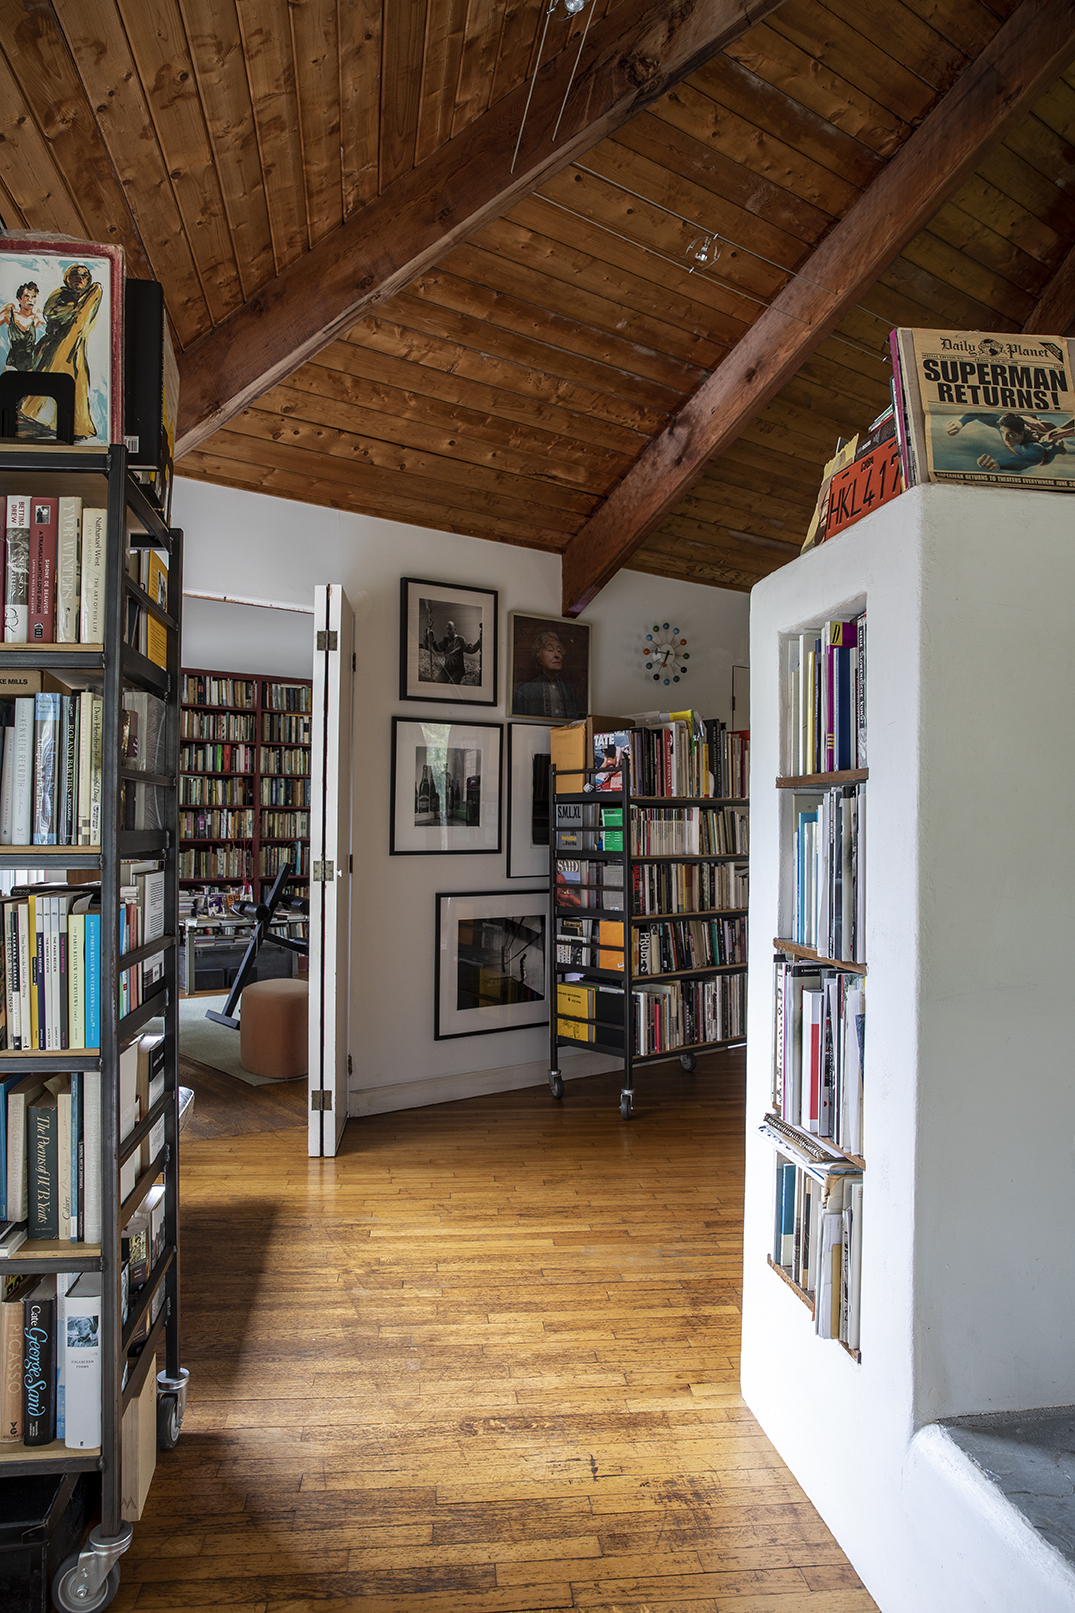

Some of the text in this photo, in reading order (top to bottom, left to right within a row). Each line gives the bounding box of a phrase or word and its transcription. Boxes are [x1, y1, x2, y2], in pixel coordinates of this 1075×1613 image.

[940, 338, 976, 356] Daily
[1006, 343, 1048, 358] Planet
[923, 359, 1068, 392] SUPERMAN
[938, 383, 1061, 410] RETURNS!
[828, 479, 862, 530] HKL
[62, 504, 74, 600] YVOR WINTERS
[19, 718, 27, 751] KENNETH
[594, 735, 615, 746] TATE
[17, 755, 26, 787] REXROTH
[92, 764, 100, 787] Beautiful
[558, 806, 581, 819] S,M,L,XL
[557, 861, 578, 872] SAID
[12, 1097, 21, 1108] THE
[91, 1105, 97, 1114] ED
[10, 1108, 21, 1133] LETTERS
[10, 1134, 20, 1142] OF
[10, 1159, 20, 1178] POUND
[36, 1116, 51, 1224] The Poems of W. B. Yeats
[7, 1324, 22, 1394] PICASSO
[24, 1305, 48, 1417] Cate George Sand
